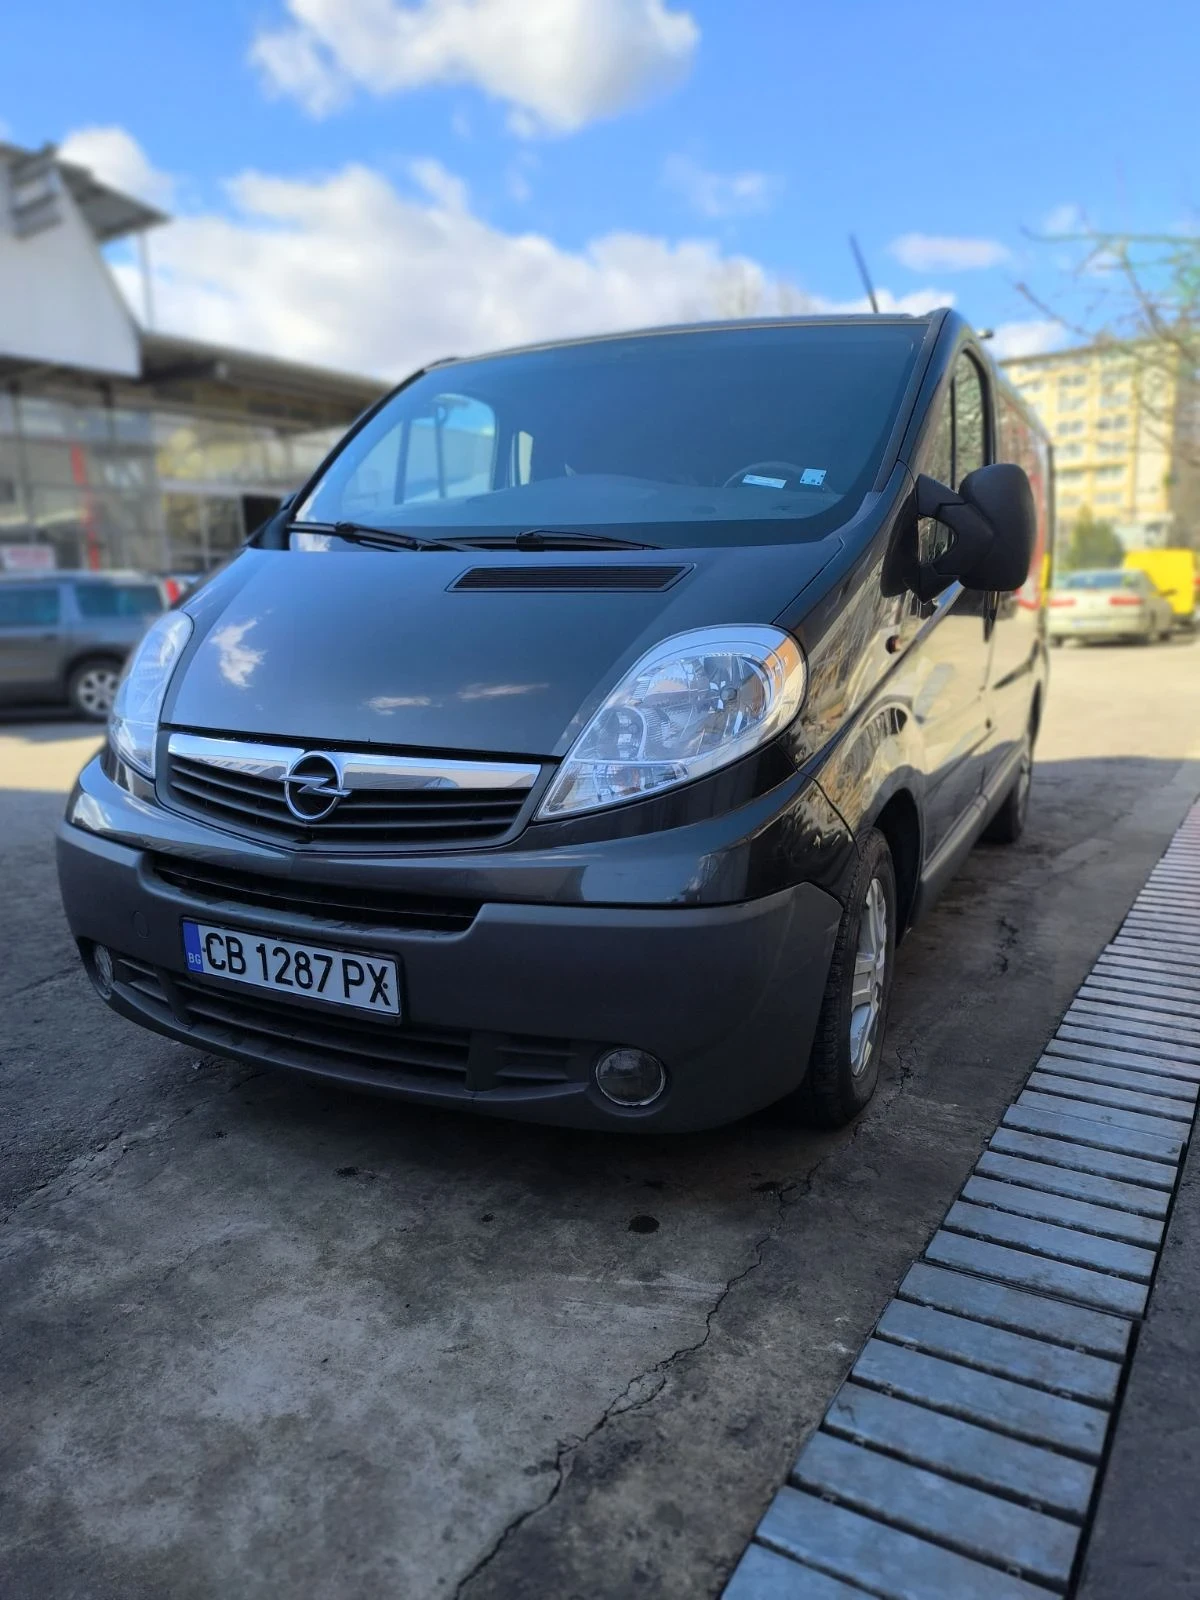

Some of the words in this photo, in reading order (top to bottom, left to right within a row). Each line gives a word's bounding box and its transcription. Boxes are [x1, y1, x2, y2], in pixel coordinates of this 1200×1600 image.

[188, 952, 201, 965] BG
[205, 932, 247, 975] CB
[256, 943, 334, 993] 1287
[342, 958, 391, 1006] PX
